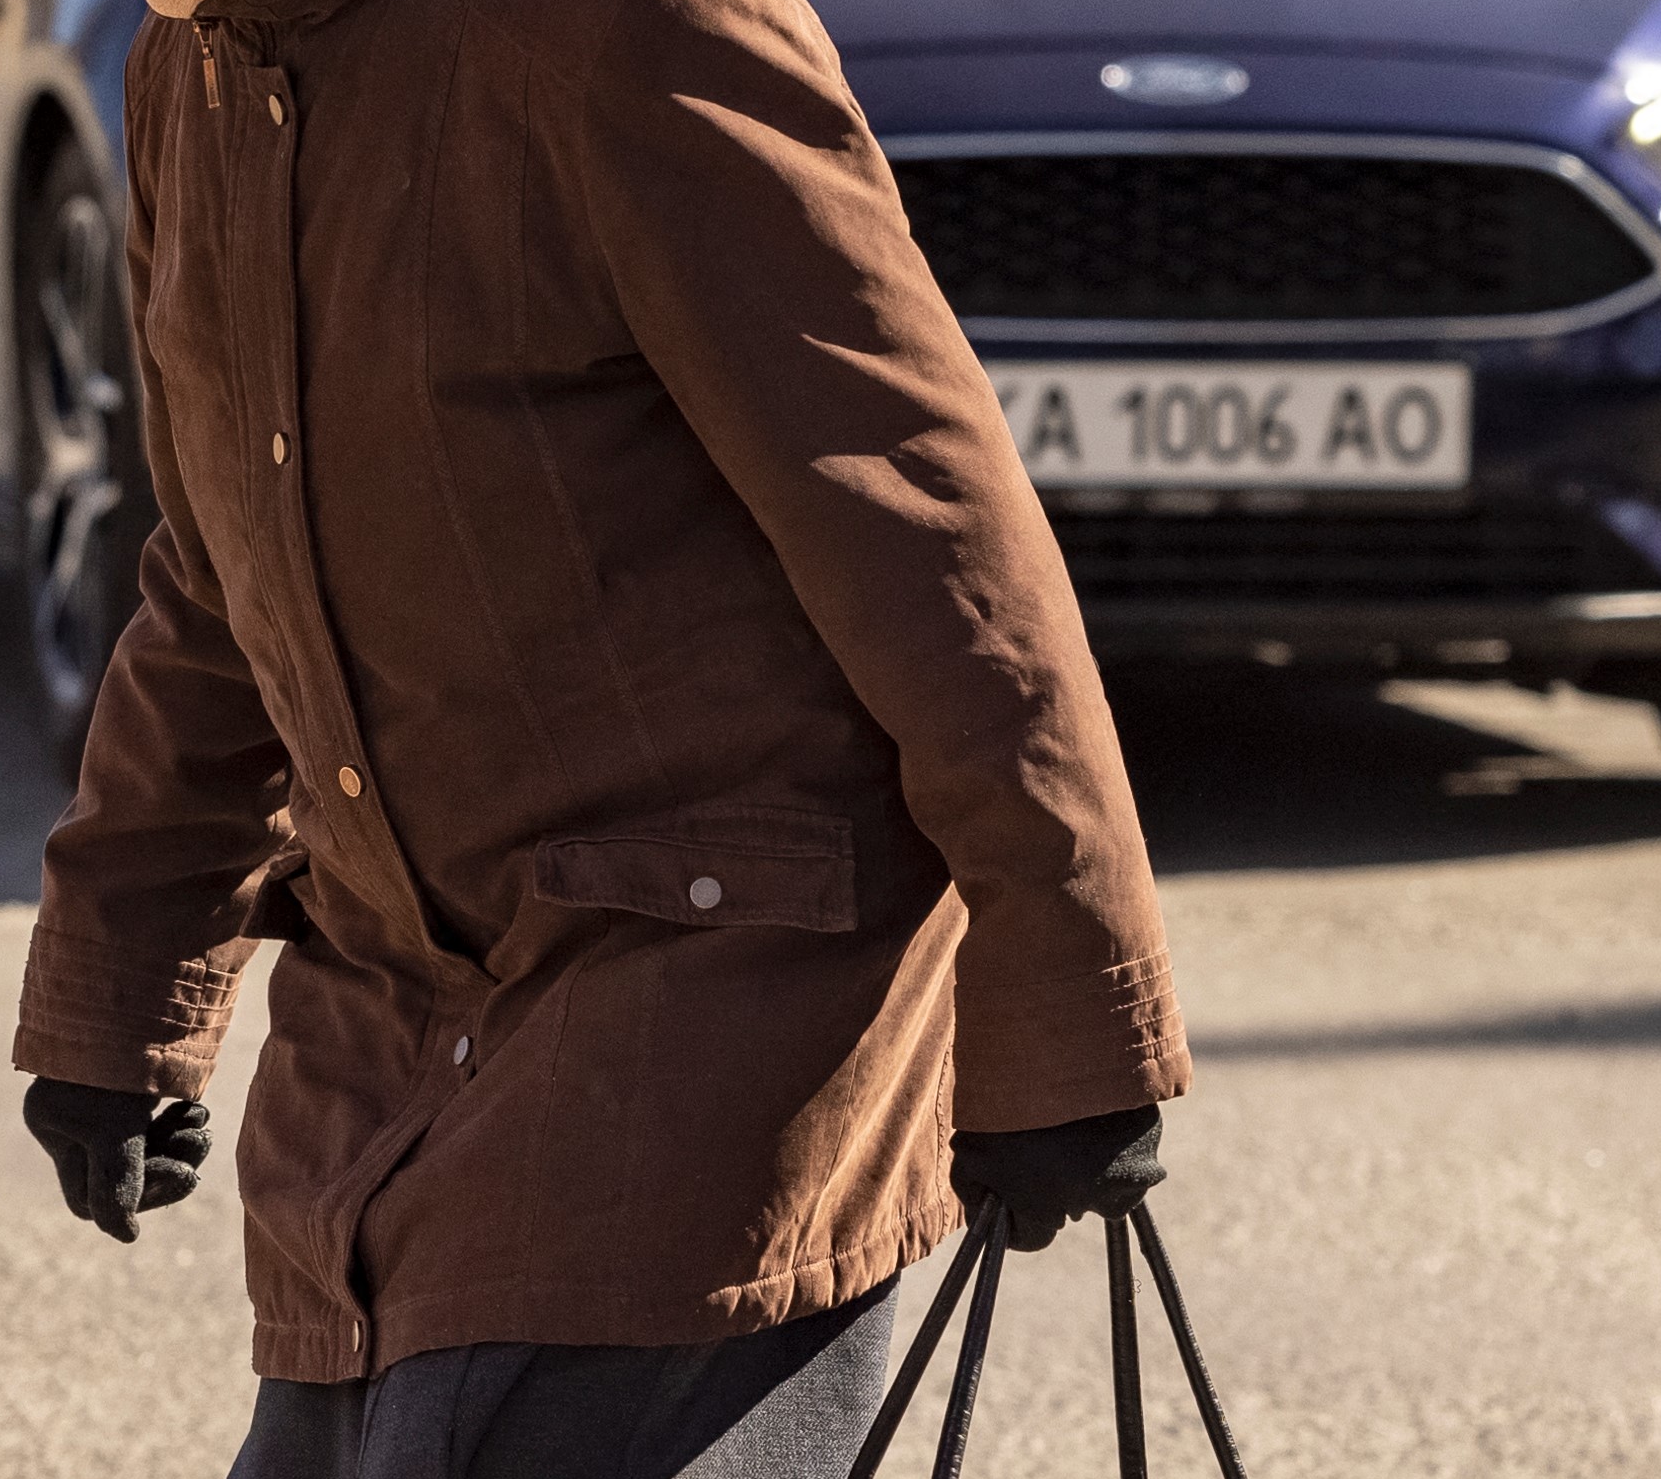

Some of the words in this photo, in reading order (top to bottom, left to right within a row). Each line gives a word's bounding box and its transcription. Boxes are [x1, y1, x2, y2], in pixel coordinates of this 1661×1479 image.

[999, 383, 1082, 461] A
[1113, 384, 1297, 463] 1006
[1322, 385, 1444, 464] AO
